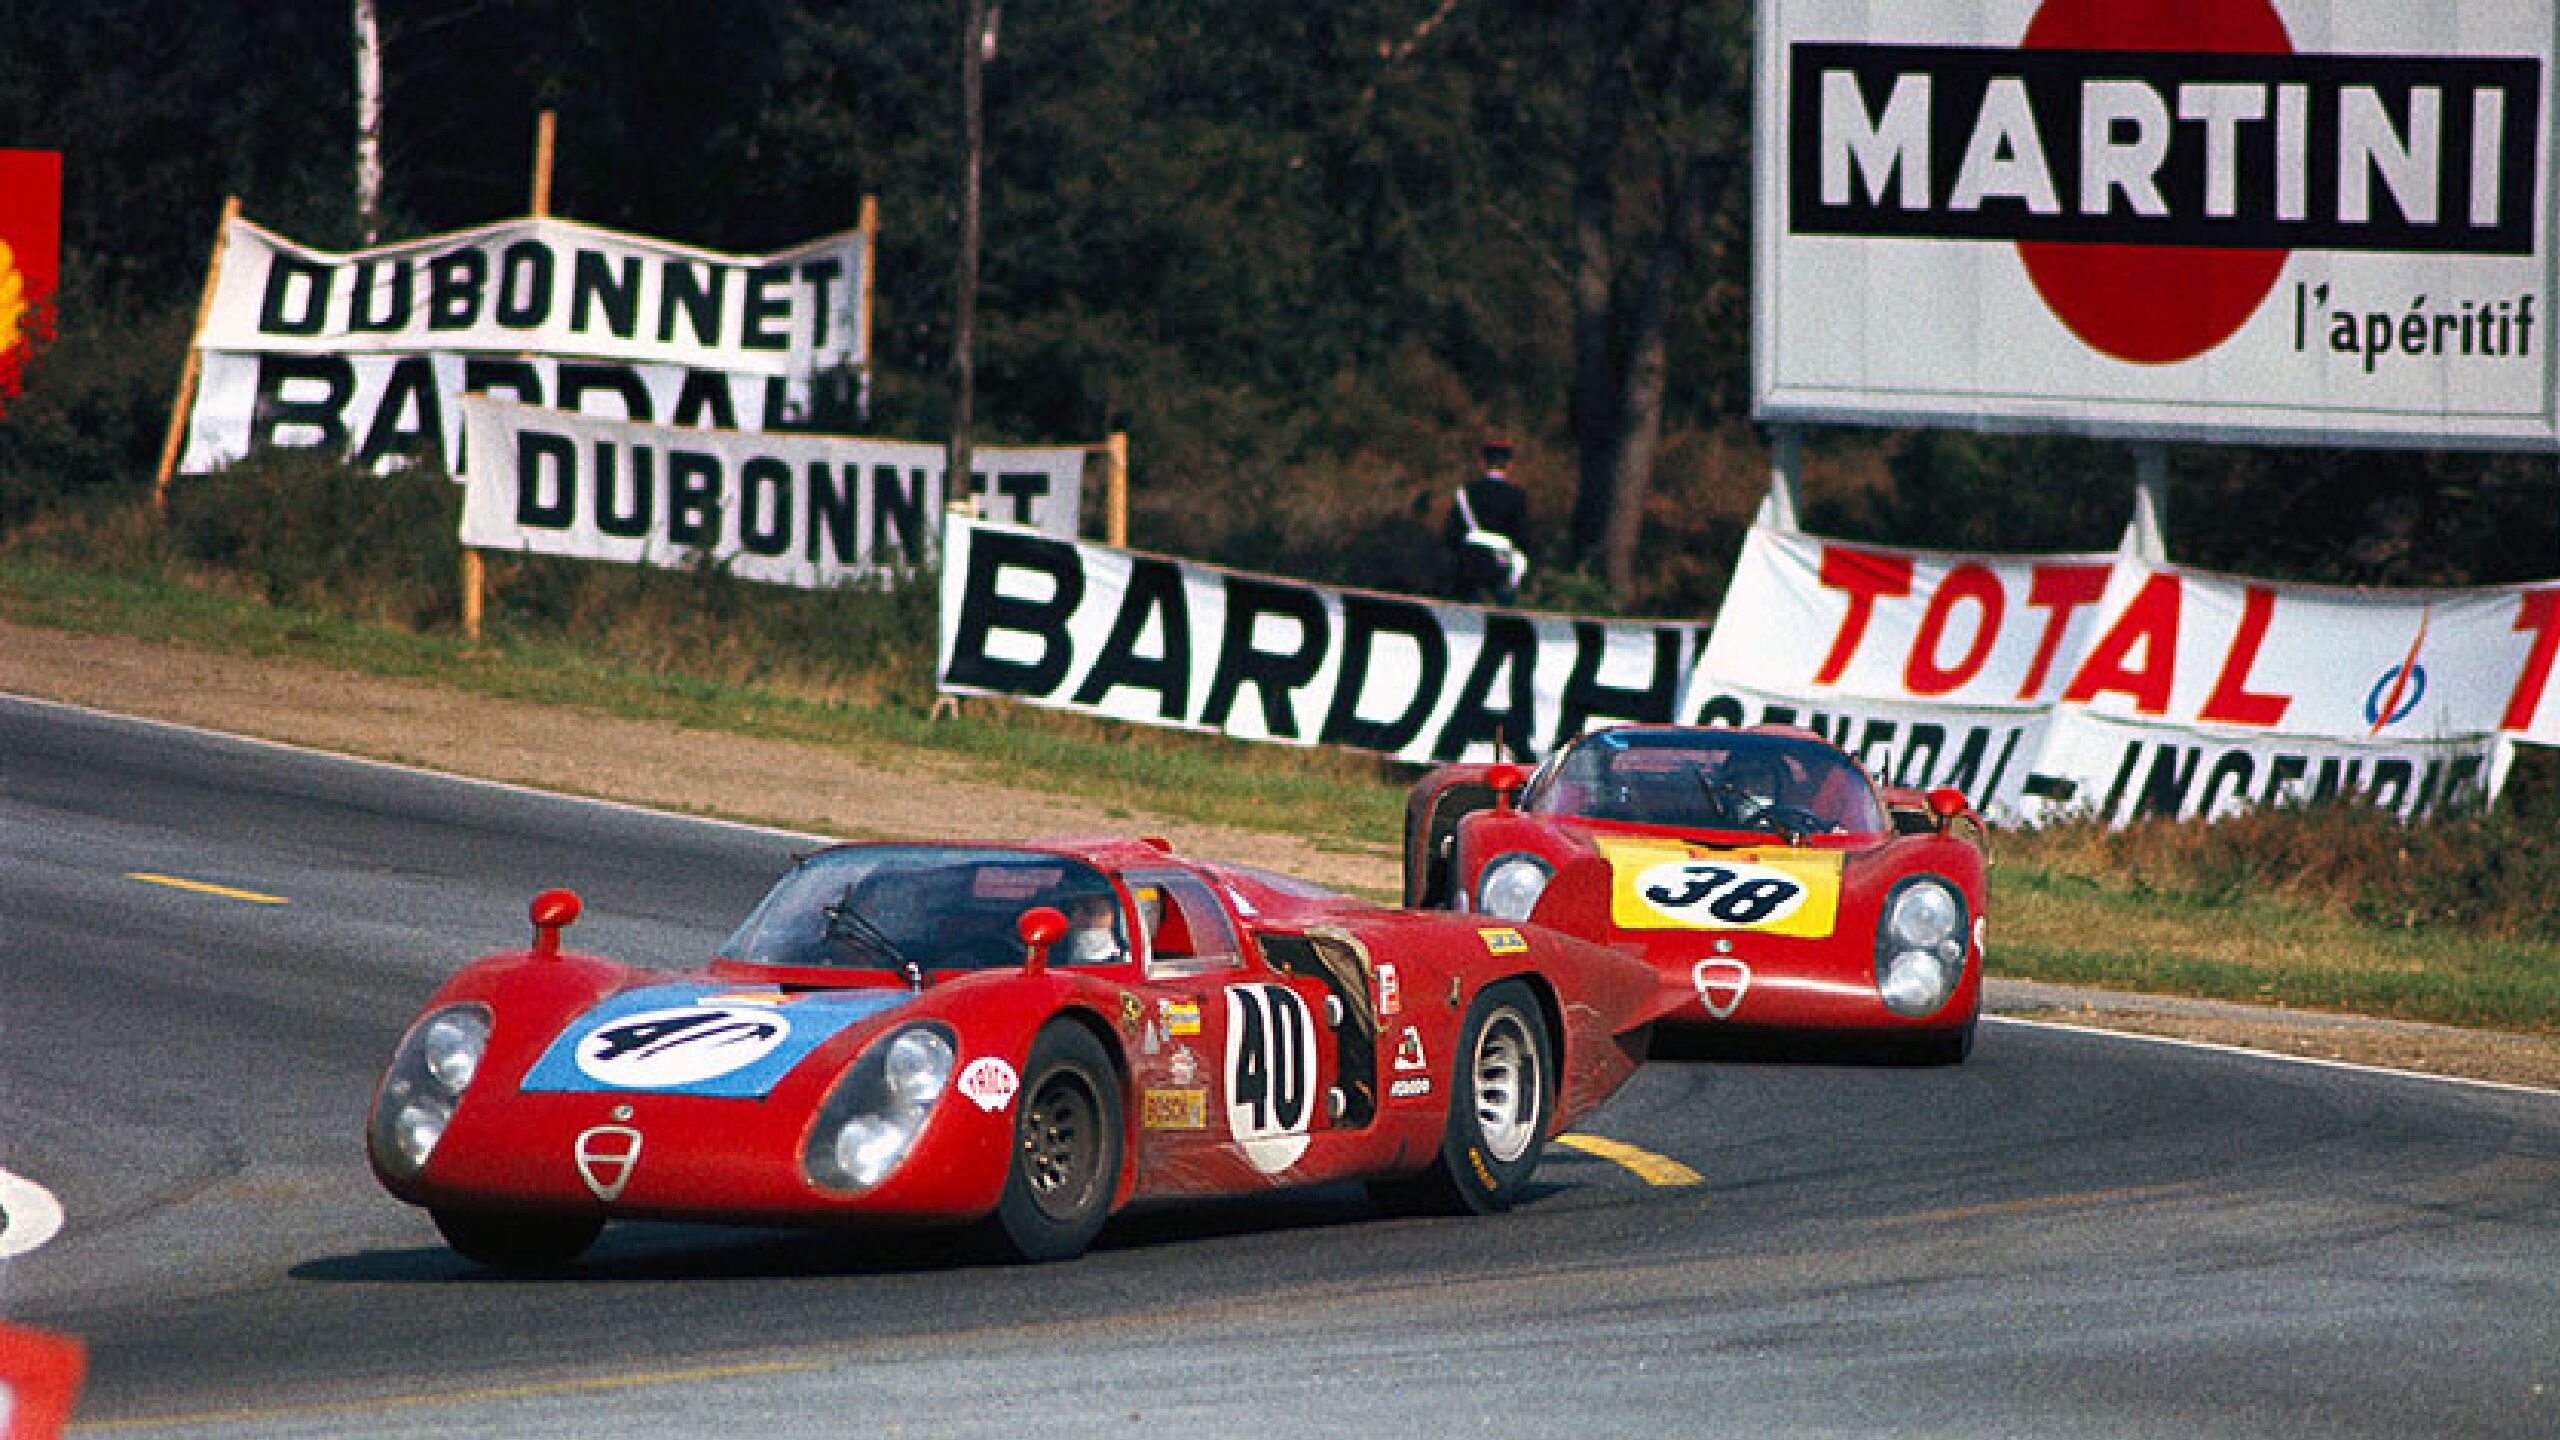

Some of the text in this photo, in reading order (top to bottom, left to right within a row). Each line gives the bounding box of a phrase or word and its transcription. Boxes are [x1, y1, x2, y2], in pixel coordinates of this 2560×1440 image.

[1819, 68, 2506, 229] MARTINI
[258, 238, 842, 352] DUBONNET
[2294, 280, 2535, 372] l'apéritif
[515, 429, 1050, 567] DUBONNT
[945, 527, 1713, 764] BARDAH
[1811, 544, 2294, 727] TOTAL
[1645, 866, 1799, 923] 38
[1234, 986, 1305, 1131] 40
